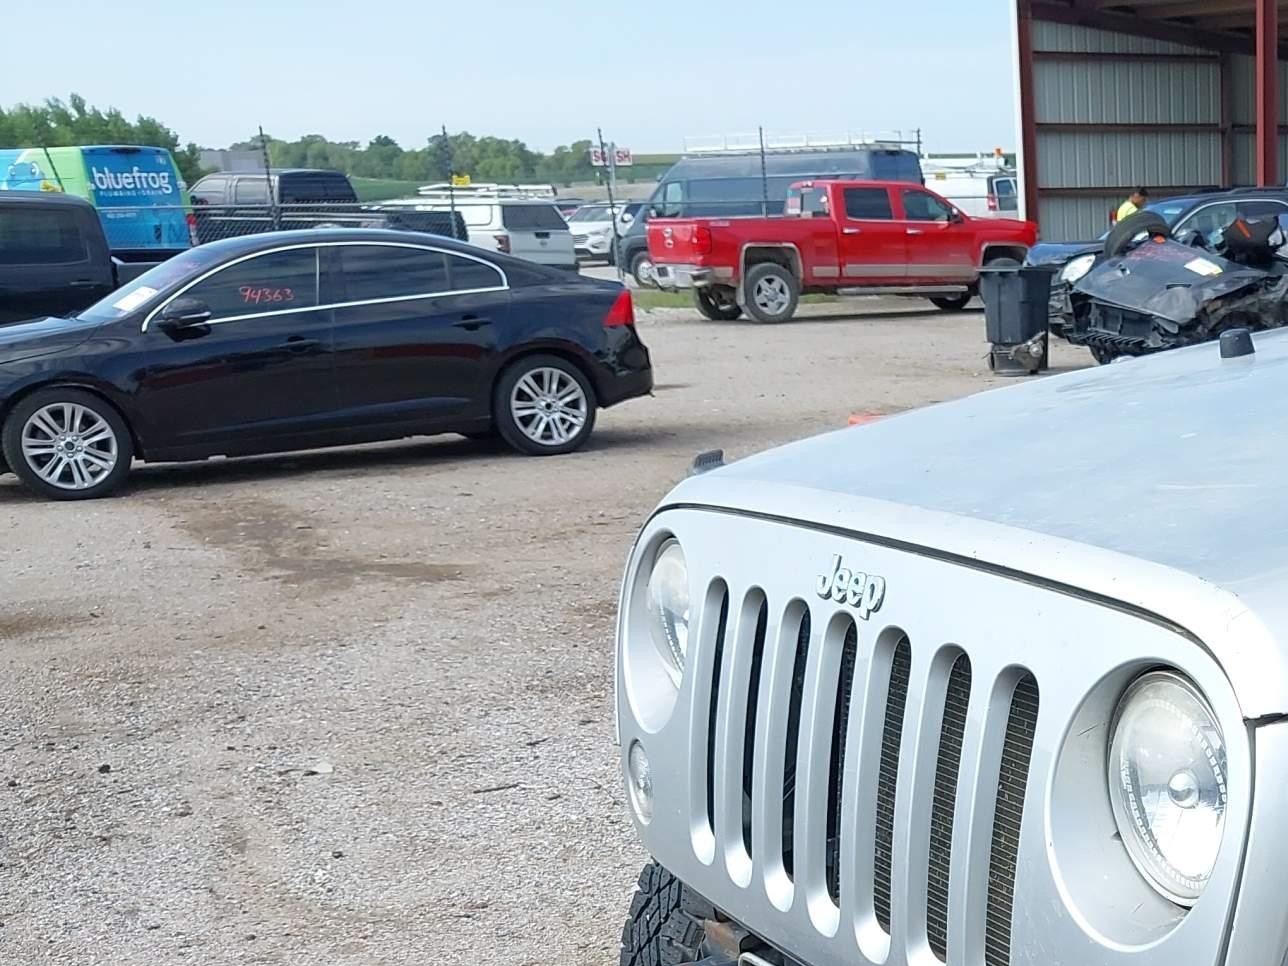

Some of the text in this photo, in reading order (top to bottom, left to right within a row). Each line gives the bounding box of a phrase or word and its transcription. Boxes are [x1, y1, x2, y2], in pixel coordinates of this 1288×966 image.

[91, 166, 172, 194] bluefrog
[239, 286, 296, 304] 94363
[816, 553, 886, 621] Jeep
